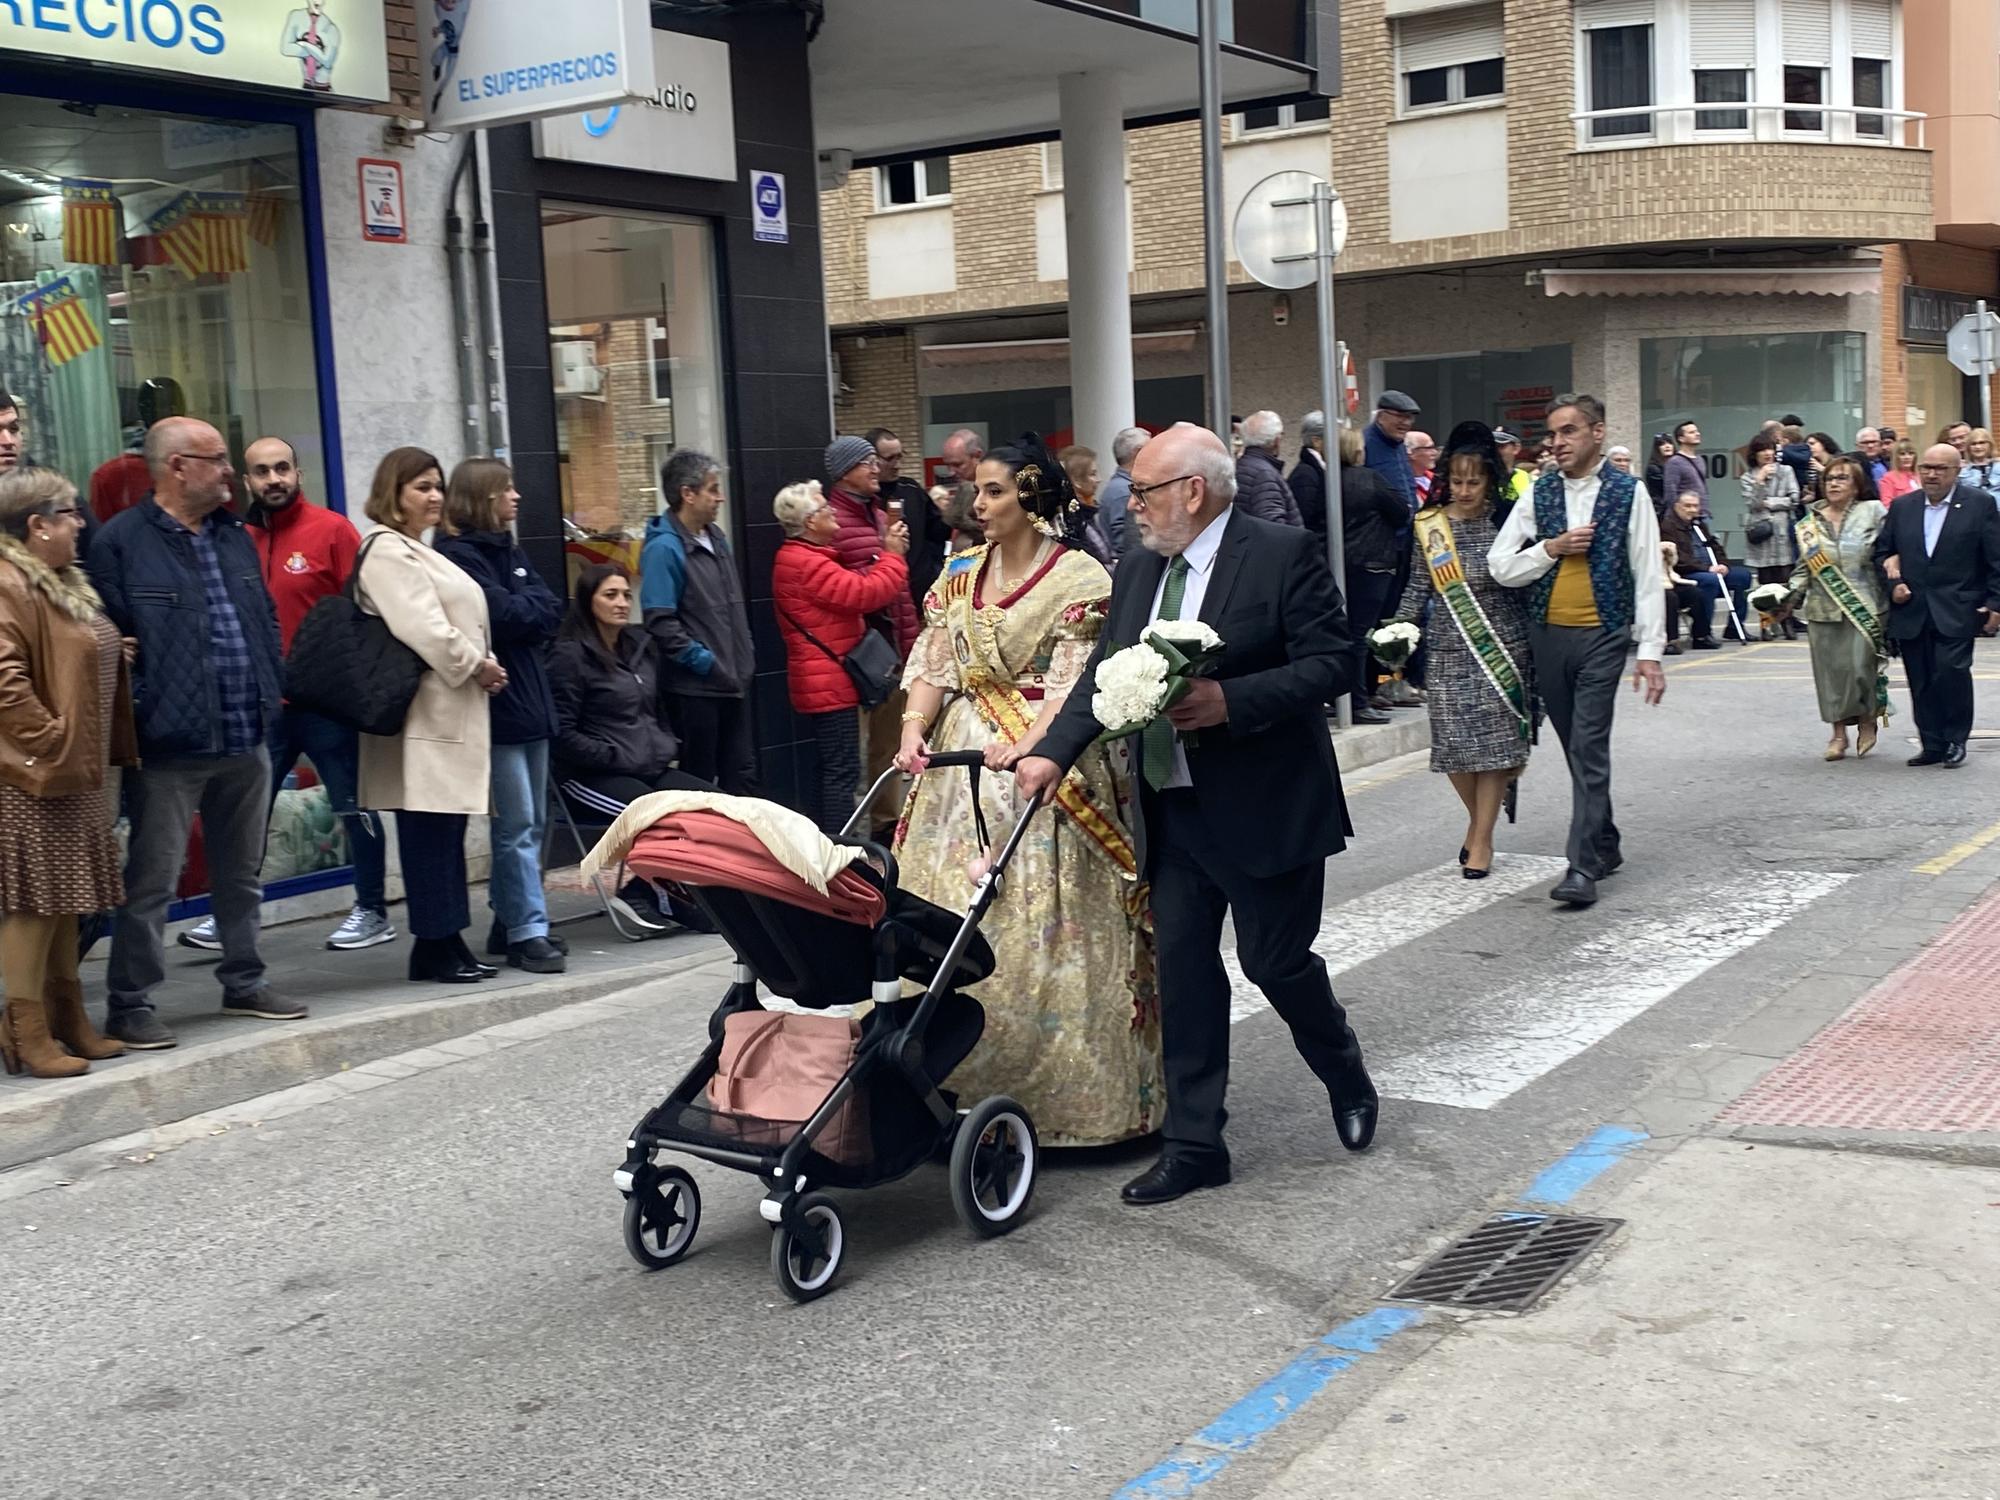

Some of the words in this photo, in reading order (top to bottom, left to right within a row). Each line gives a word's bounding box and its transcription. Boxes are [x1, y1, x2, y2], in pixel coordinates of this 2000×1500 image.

[458, 79, 479, 102] EL
[484, 51, 617, 98] SUPERPRECIOS
[645, 83, 697, 112] udio
